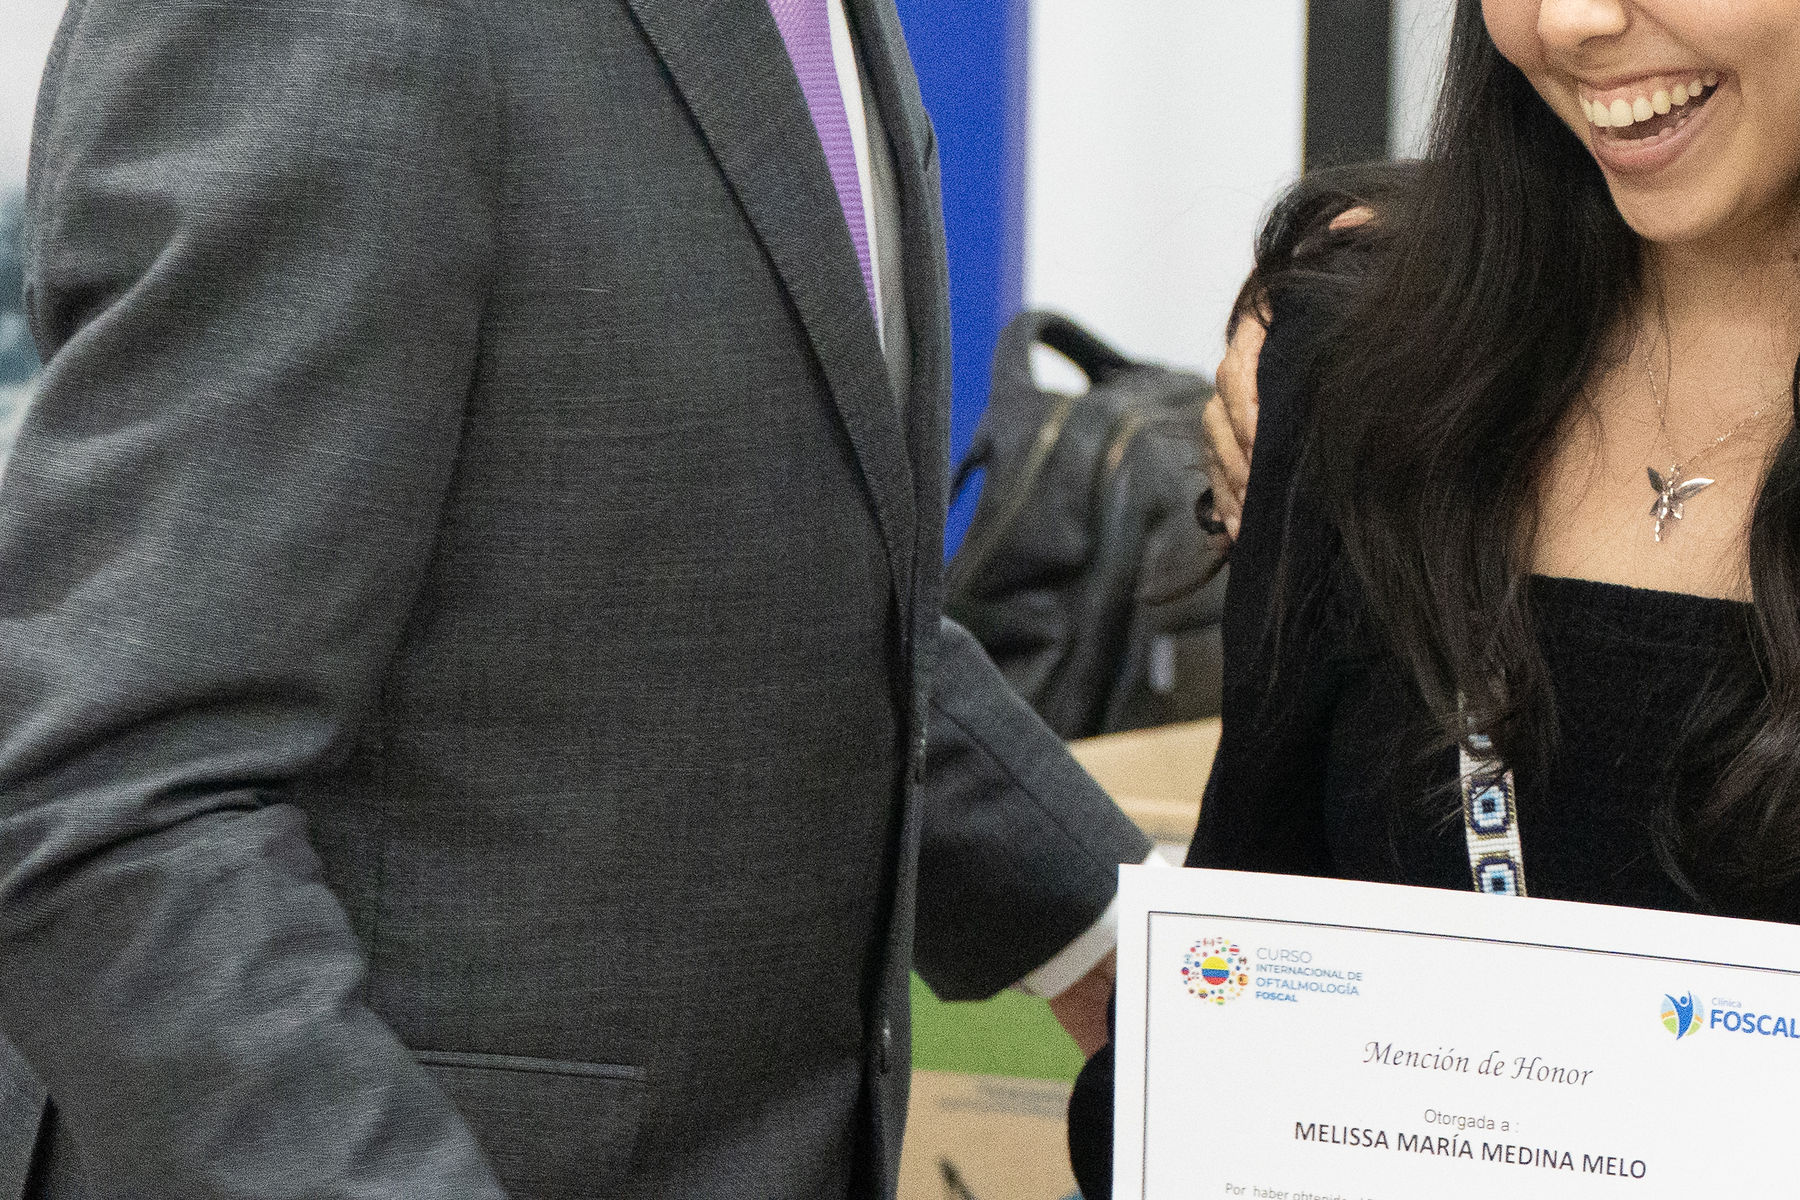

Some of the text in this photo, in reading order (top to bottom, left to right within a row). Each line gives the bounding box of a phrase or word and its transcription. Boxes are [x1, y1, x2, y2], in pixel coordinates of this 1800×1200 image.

[1256, 947, 1312, 964] CURSO
[1256, 964, 1363, 982] INTERNACIONAL DE
[1256, 977, 1360, 996] OFTALMOLOGÍA
[1256, 990, 1298, 1003] FOSCAL
[1710, 1009, 1800, 1039] FOSCAL
[1363, 1041, 1594, 1086] Mención de Honor
[1424, 1109, 1495, 1131] Otorgada
[1501, 1120, 1510, 1132] a
[1295, 1121, 1646, 1180] MELISSA MARÍA MEDINA MELO
[1225, 1182, 1246, 1196] Por
[1253, 1185, 1289, 1200] haber
